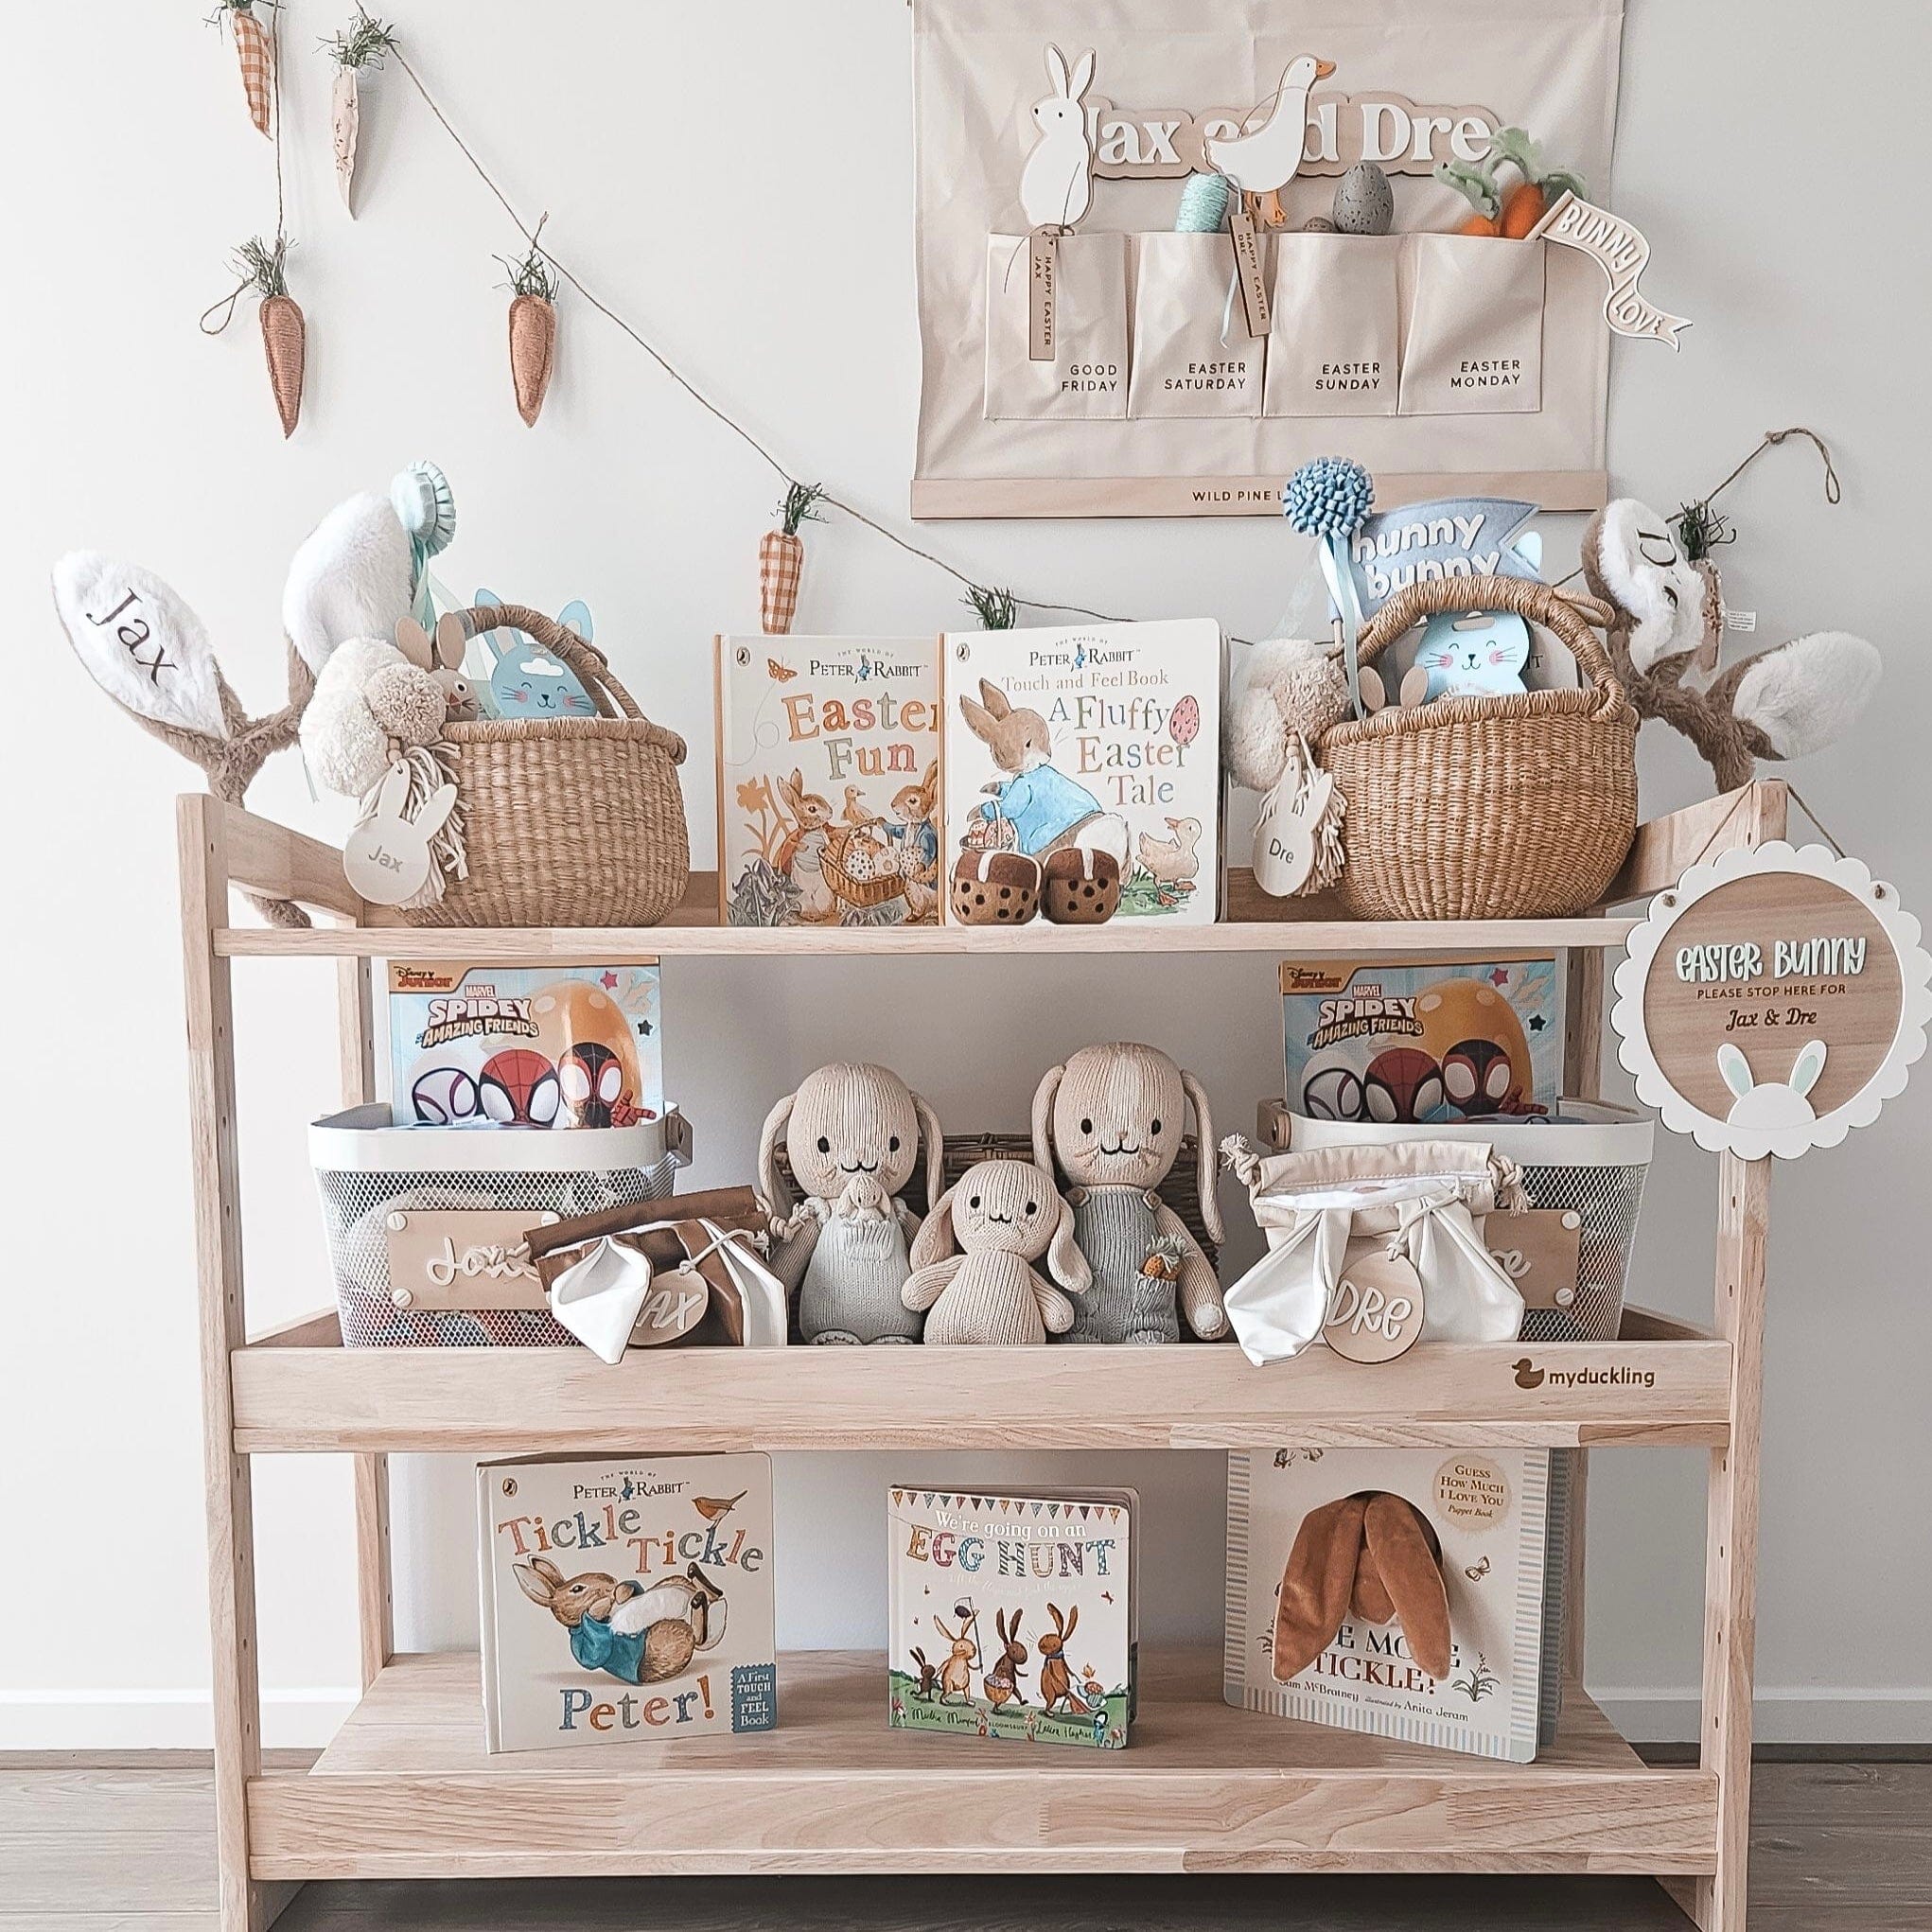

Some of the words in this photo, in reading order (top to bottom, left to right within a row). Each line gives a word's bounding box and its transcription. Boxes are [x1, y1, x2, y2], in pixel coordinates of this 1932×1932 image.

[1361, 102, 1492, 162] Dre
[1556, 203, 1642, 273] BUNNY
[1245, 233, 1257, 270] HAPPY
[1254, 276, 1267, 320] EASTER
[1613, 297, 1665, 335] LOVE
[1070, 364, 1117, 377] GOOD
[1188, 362, 1246, 375] EASTER
[1322, 362, 1380, 375] EASTER
[1461, 360, 1521, 373] EASTER
[1062, 380, 1117, 393] FRIDAY
[1164, 378, 1246, 391] SATURDAY
[1315, 378, 1380, 391] SUNDAY
[1450, 375, 1521, 388] MONDAY
[1192, 491, 1231, 501] WILD
[1238, 490, 1272, 501] PINE
[1352, 514, 1486, 564] hunny
[1364, 552, 1501, 600] bunny
[85, 588, 179, 687] Jax
[809, 659, 855, 676] PETER
[874, 660, 922, 679] RABBIT
[1029, 651, 1071, 667] PETER
[1088, 648, 1134, 665] RABBIT
[1001, 675, 1049, 693] Touch
[1056, 674, 1083, 690] and
[1091, 672, 1123, 689] Feel
[1128, 669, 1169, 686] Book
[1048, 696, 1071, 722] A
[1074, 695, 1170, 734] Fluffy
[823, 737, 918, 781] Fun
[1076, 735, 1190, 775] Easter
[1107, 774, 1174, 806] Tale
[367, 843, 403, 874] Jax
[1269, 838, 1295, 865] Dre
[465, 985, 496, 998] MARVEL
[1352, 984, 1381, 998] MARVEL
[1696, 988, 1742, 1000] PLEASE
[1747, 986, 1780, 997] STOP
[1783, 985, 1817, 996] HERE
[1820, 984, 1846, 995] FOR
[428, 999, 532, 1027] SPIDEY
[1319, 997, 1417, 1027] SPIDEY
[1726, 1010, 1758, 1031] Jax
[1764, 1008, 1780, 1027] &
[1785, 1007, 1817, 1026] Dre
[422, 1020, 483, 1048] AMAZING
[484, 1018, 539, 1038] FRIENDS
[1312, 1020, 1369, 1049] AMAZING
[1371, 1018, 1424, 1037] FRIENDS
[635, 1290, 703, 1330] AX
[1548, 1366, 1656, 1389] myduckling
[1454, 1465, 1491, 1478] GUESS
[573, 1484, 618, 1499] PETER
[636, 1481, 685, 1497] RABBIT
[1440, 1476, 1468, 1488] HOW
[1470, 1480, 1503, 1494] MUCH
[1440, 1489, 1445, 1499] I
[1449, 1490, 1478, 1502] LOVE
[1481, 1494, 1504, 1506] YOU
[498, 1503, 641, 1556] Tickle
[935, 1509, 978, 1532] We're
[984, 1520, 1032, 1541] going
[1037, 1524, 1061, 1537] on
[1064, 1524, 1086, 1537] an
[626, 1527, 764, 1574] Tickle
[905, 1523, 985, 1572] EGG
[997, 1538, 1116, 1578] HUNT
[738, 1674, 746, 1683] A
[1314, 1652, 1435, 1695] TICKLE!
[737, 1681, 771, 1694] TOUCH
[746, 1692, 763, 1702] and
[1304, 1680, 1360, 1702] McBratney
[558, 1674, 715, 1731] Peter!
[741, 1701, 769, 1713] FEEL
[1404, 1700, 1433, 1715] Anita
[1435, 1706, 1469, 1722] Jeram
[741, 1712, 769, 1727] Book
